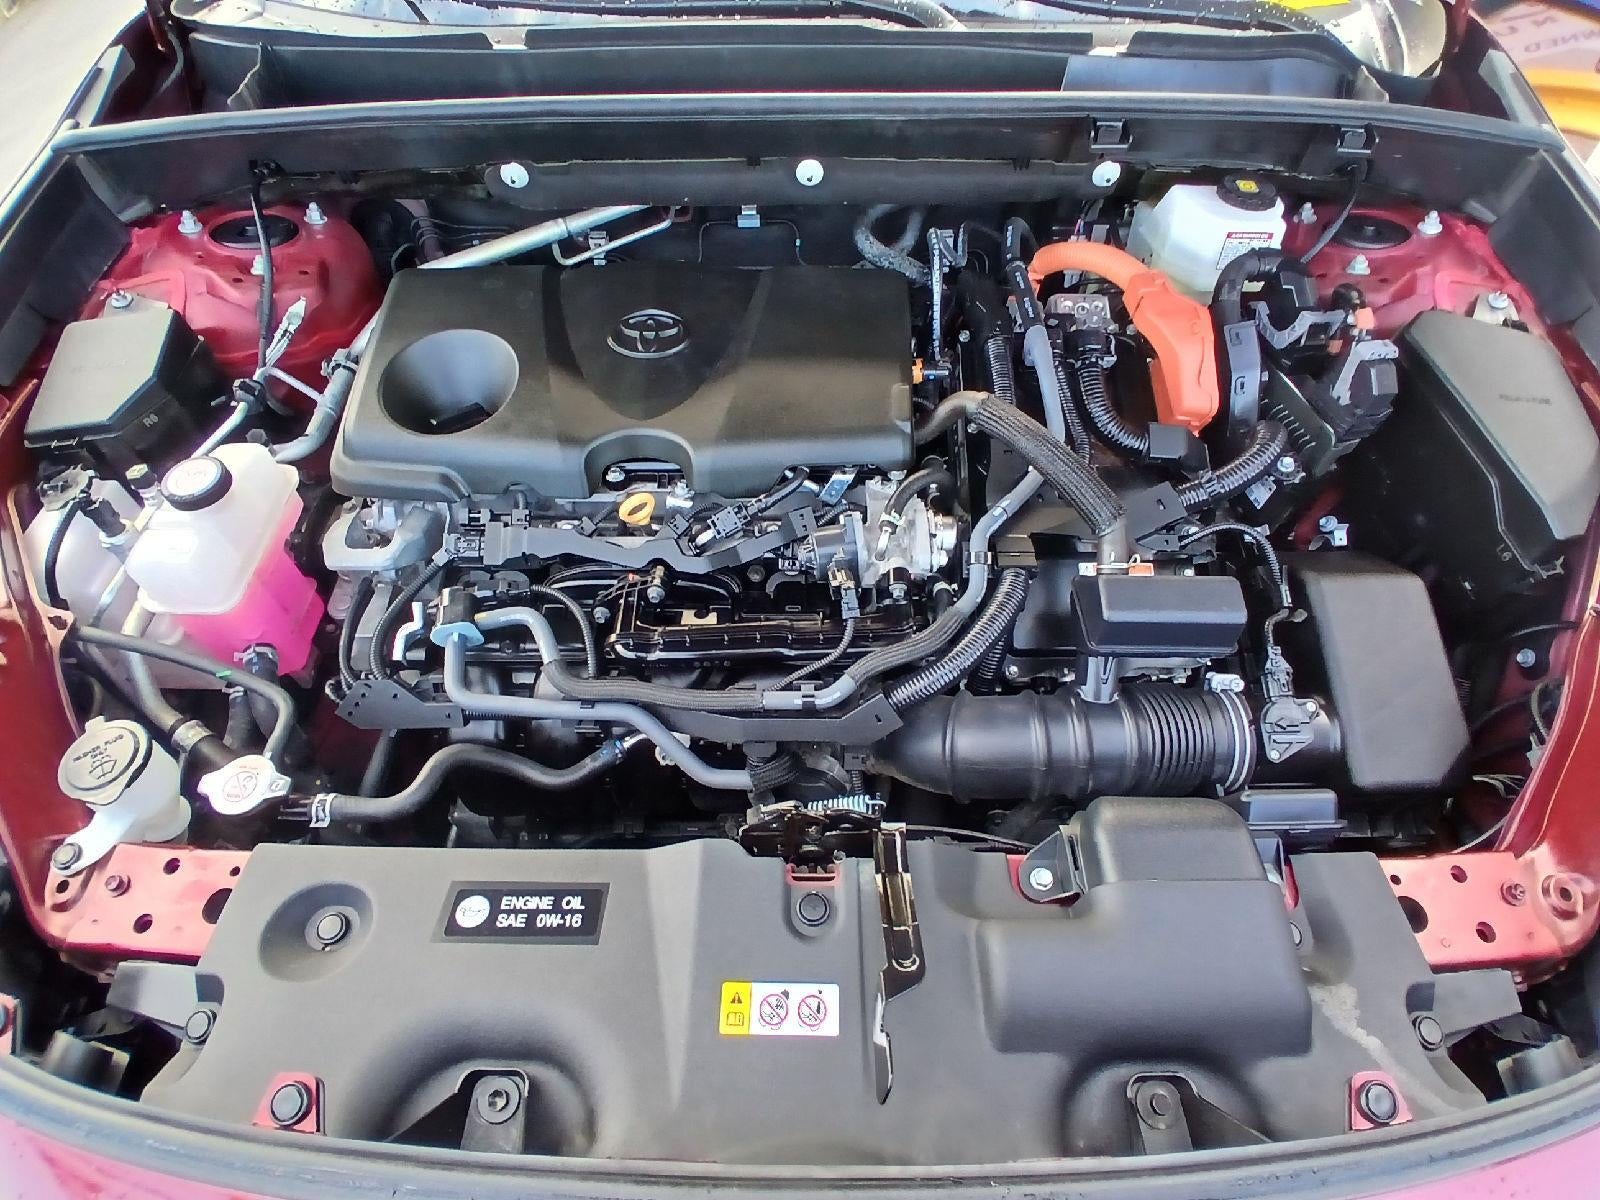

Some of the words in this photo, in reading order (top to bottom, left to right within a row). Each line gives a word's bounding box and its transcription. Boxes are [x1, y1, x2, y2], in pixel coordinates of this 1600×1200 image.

[500, 895, 555, 910] ENGINE
[561, 895, 586, 910] OIL
[495, 913, 529, 928] SAE
[535, 913, 583, 928] 0W-16
